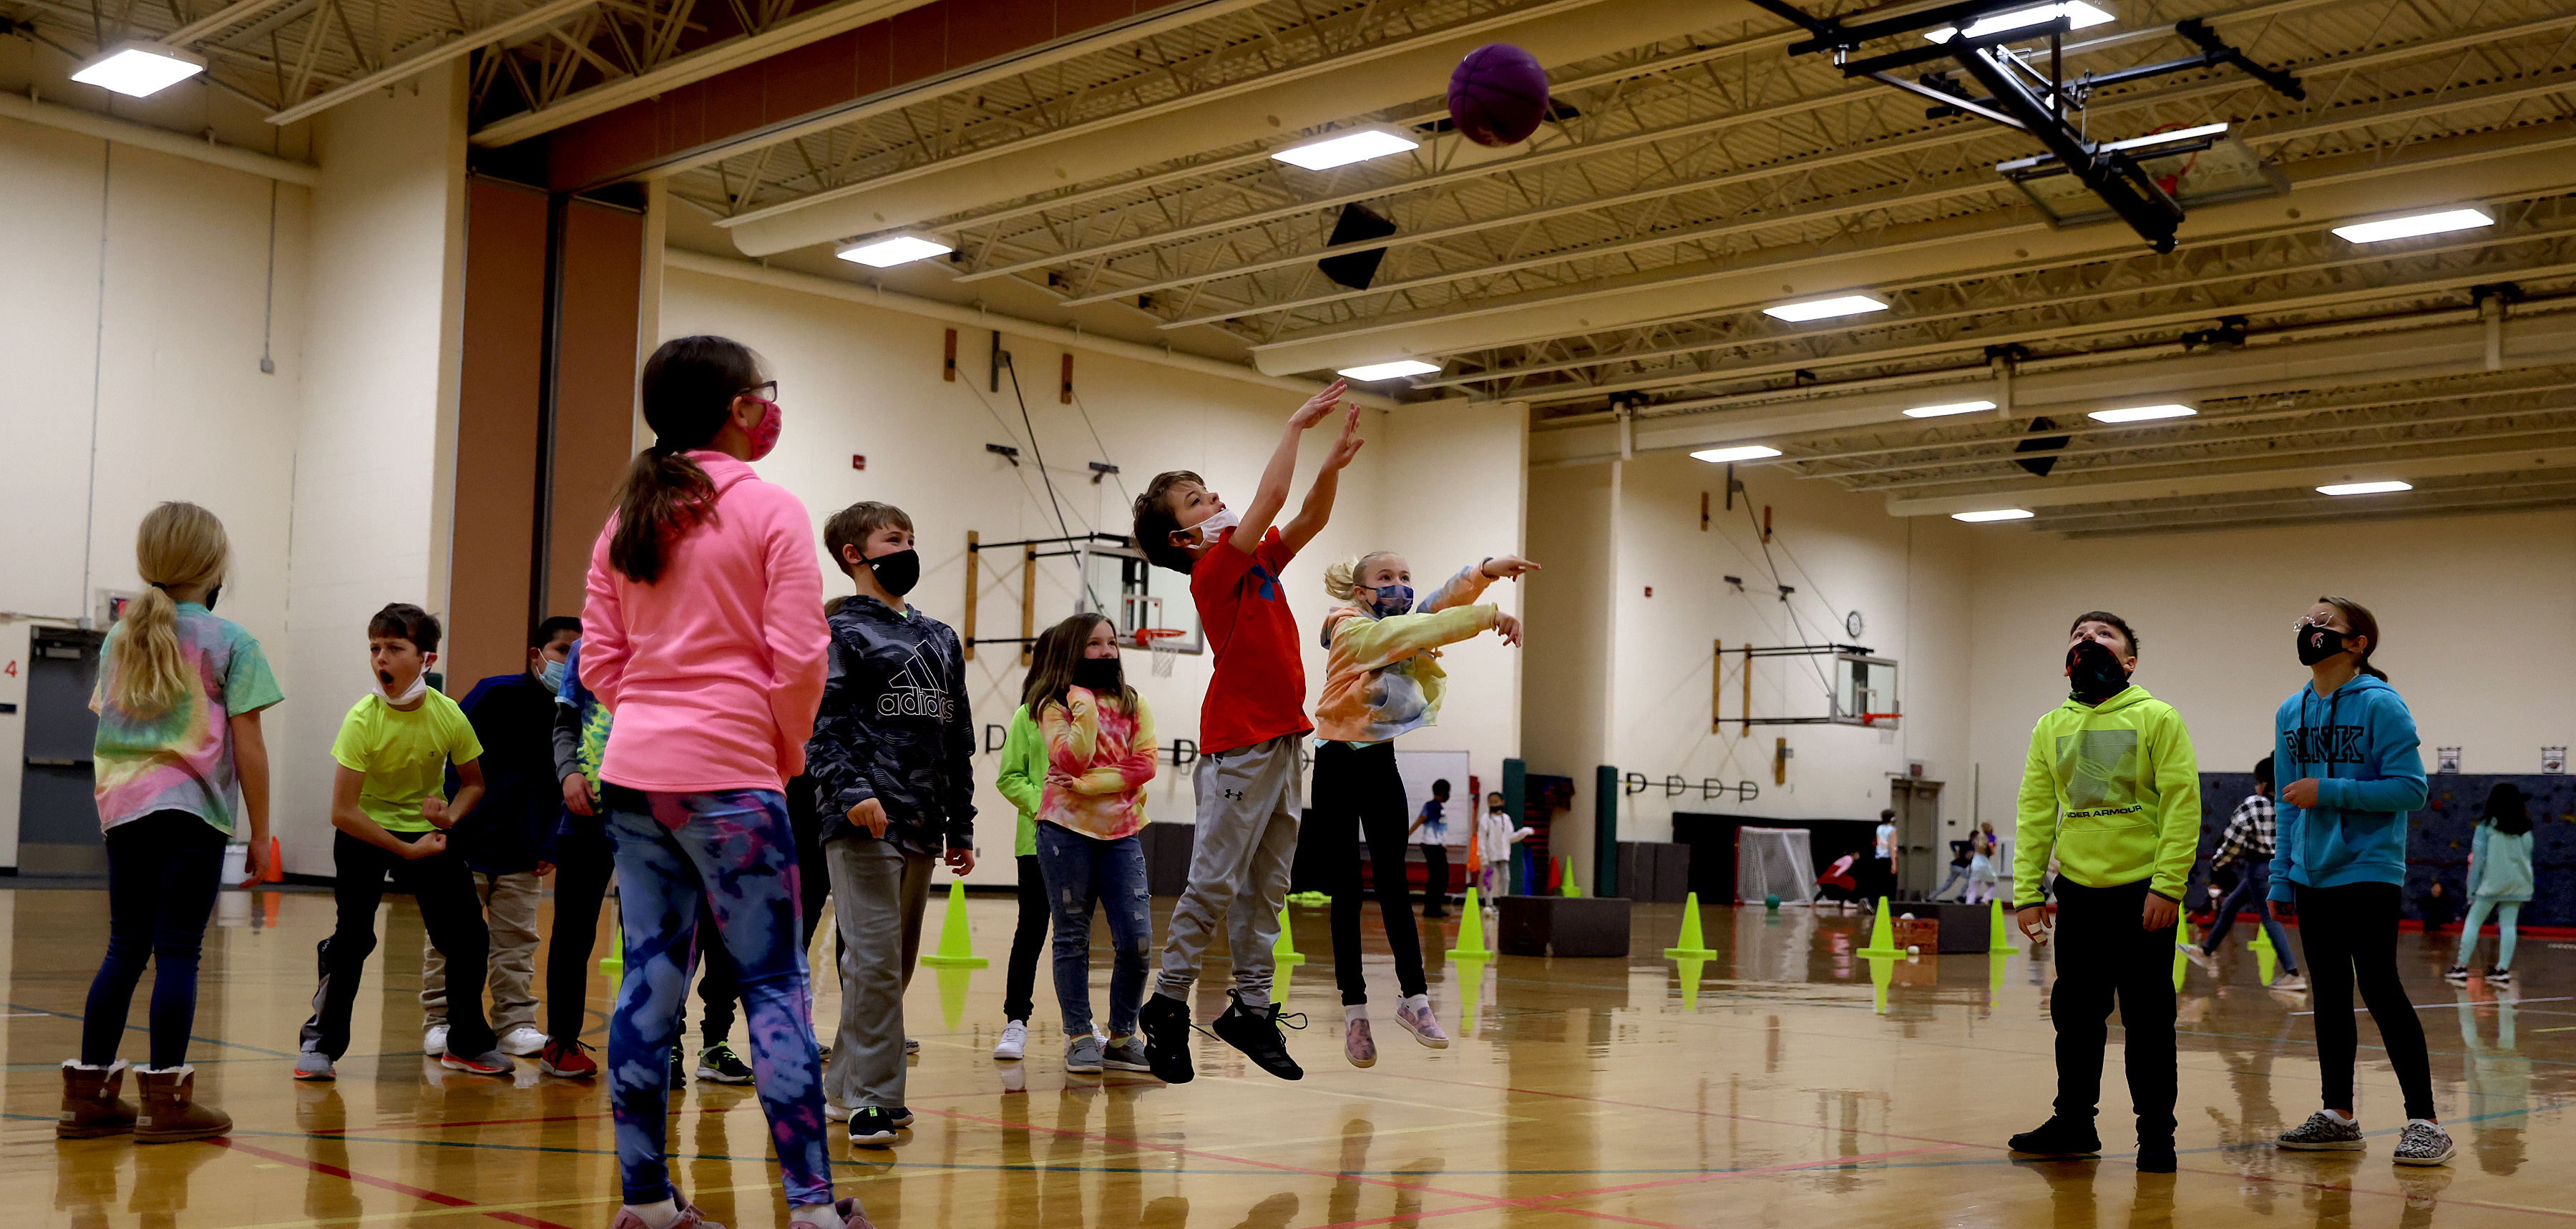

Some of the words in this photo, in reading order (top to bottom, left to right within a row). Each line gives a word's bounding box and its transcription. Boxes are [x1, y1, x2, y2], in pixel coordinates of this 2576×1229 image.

[4, 660, 17, 678] 4
[2283, 725, 2364, 765] PINK
[2093, 806, 2142, 817] ARMOUR
